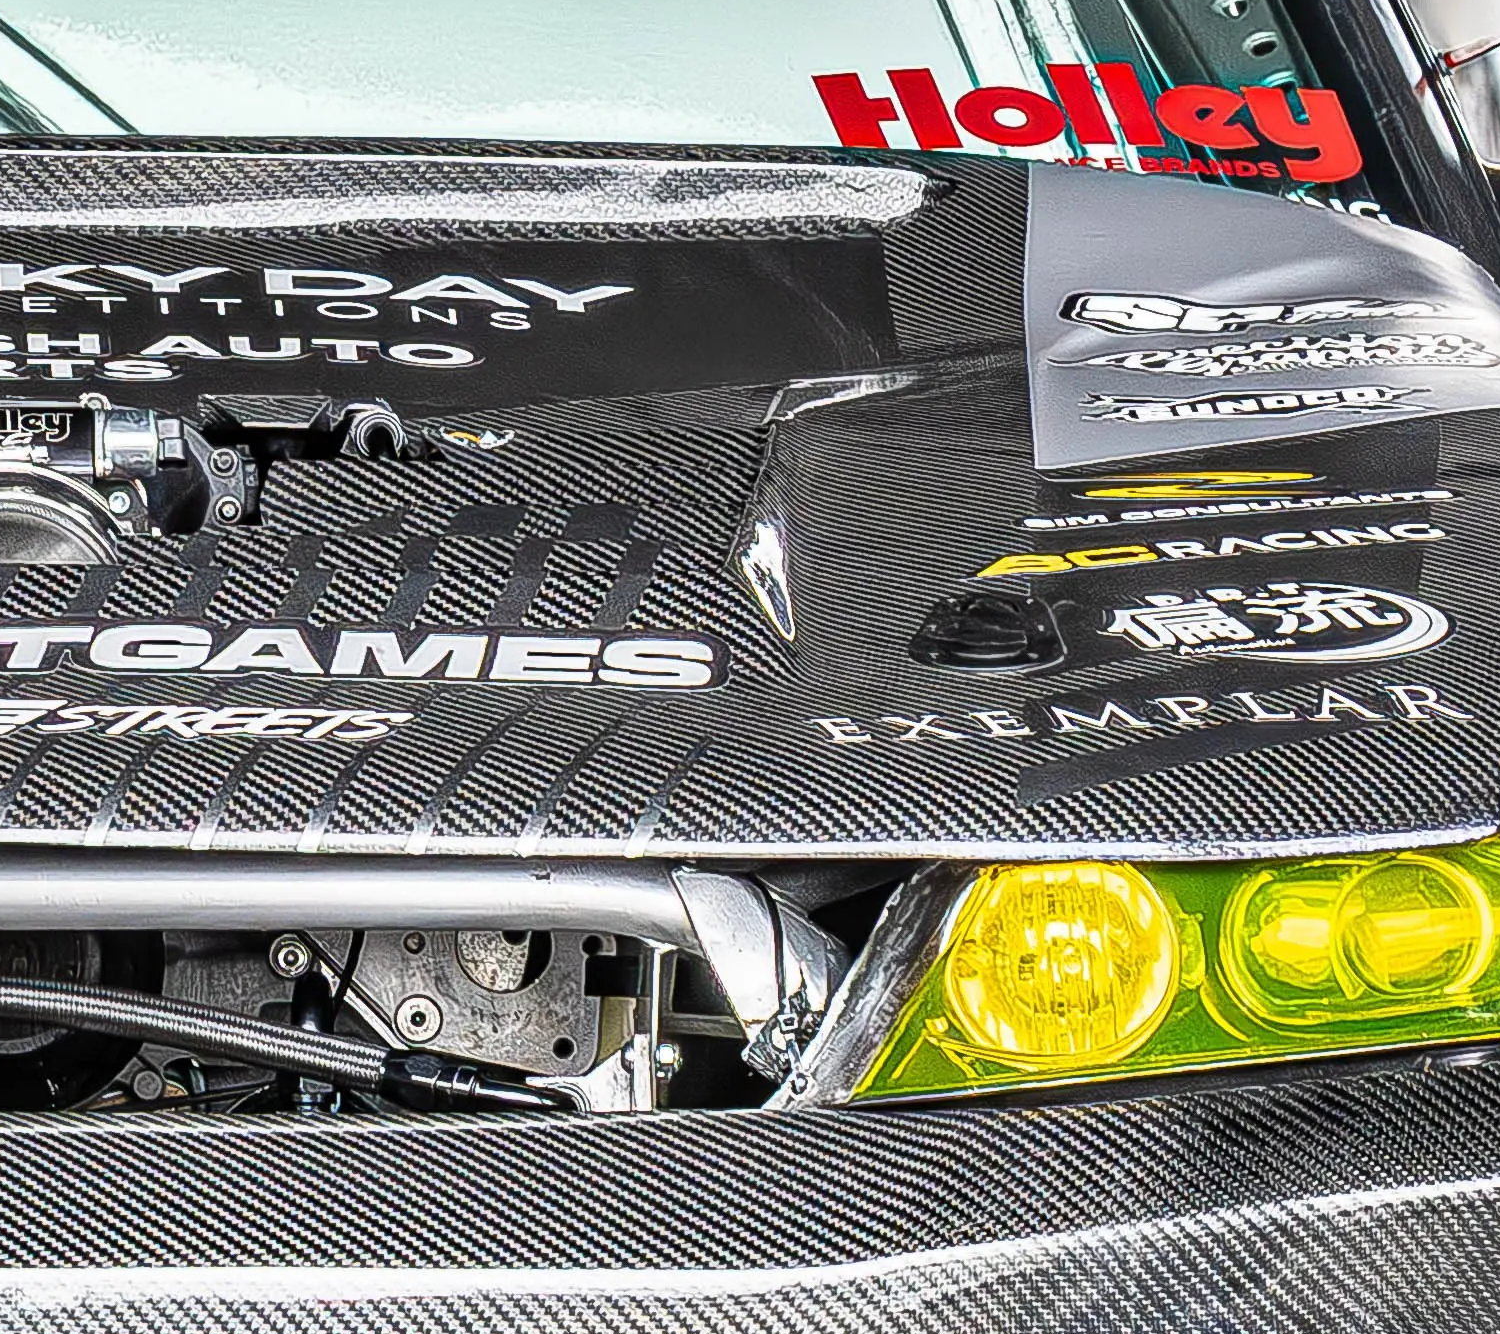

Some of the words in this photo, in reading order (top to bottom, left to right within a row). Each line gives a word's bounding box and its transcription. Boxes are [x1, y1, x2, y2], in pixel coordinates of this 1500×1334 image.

[810, 61, 1363, 184] Holley
[1140, 155, 1282, 178] BRANDS
[262, 267, 636, 313] DAY
[137, 332, 477, 367] AUTO
[1023, 514, 1109, 530] SIM
[1120, 490, 1455, 523] CONSULTANTS
[810, 682, 1476, 744] EXEMPLAR
